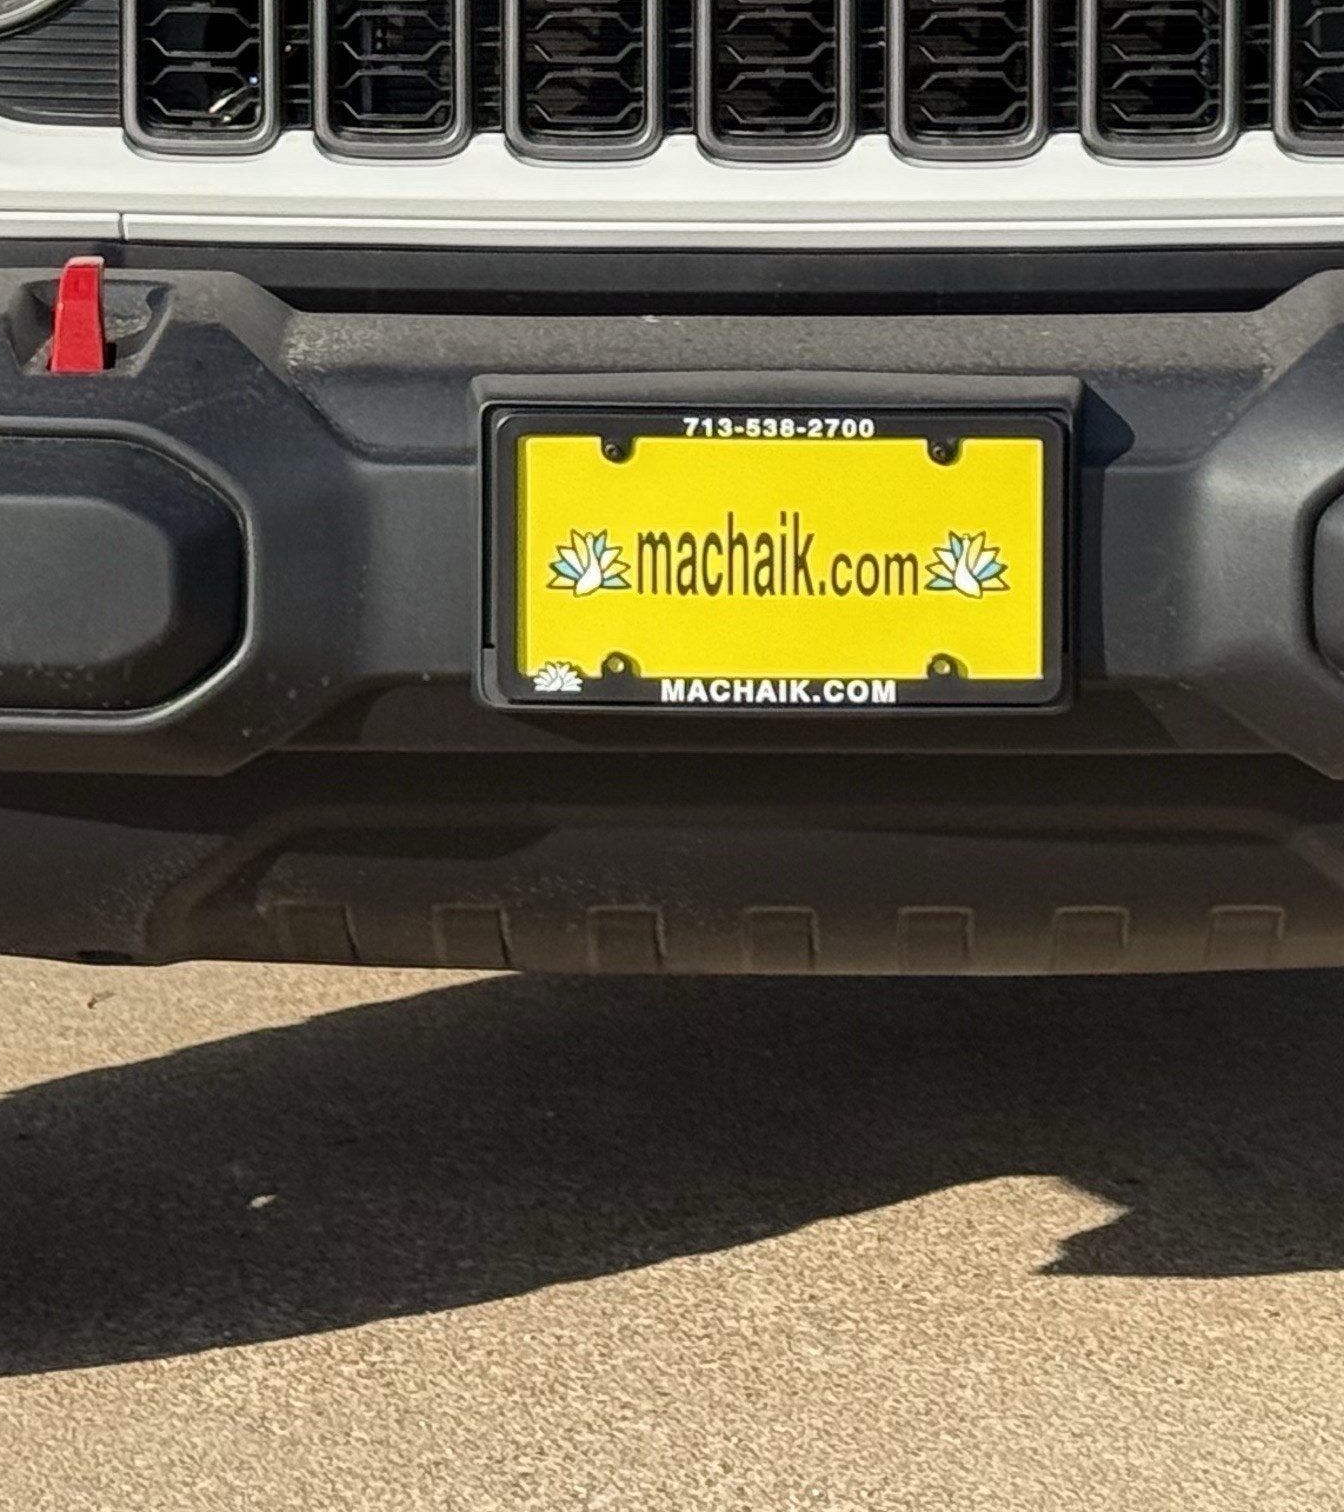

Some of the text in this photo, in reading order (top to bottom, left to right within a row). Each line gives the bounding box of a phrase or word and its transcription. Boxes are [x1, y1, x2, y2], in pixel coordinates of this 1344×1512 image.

[682, 417, 875, 438] 713-538-2700
[636, 510, 920, 596] machaik.com
[659, 678, 897, 704] MACHAIK.COM
